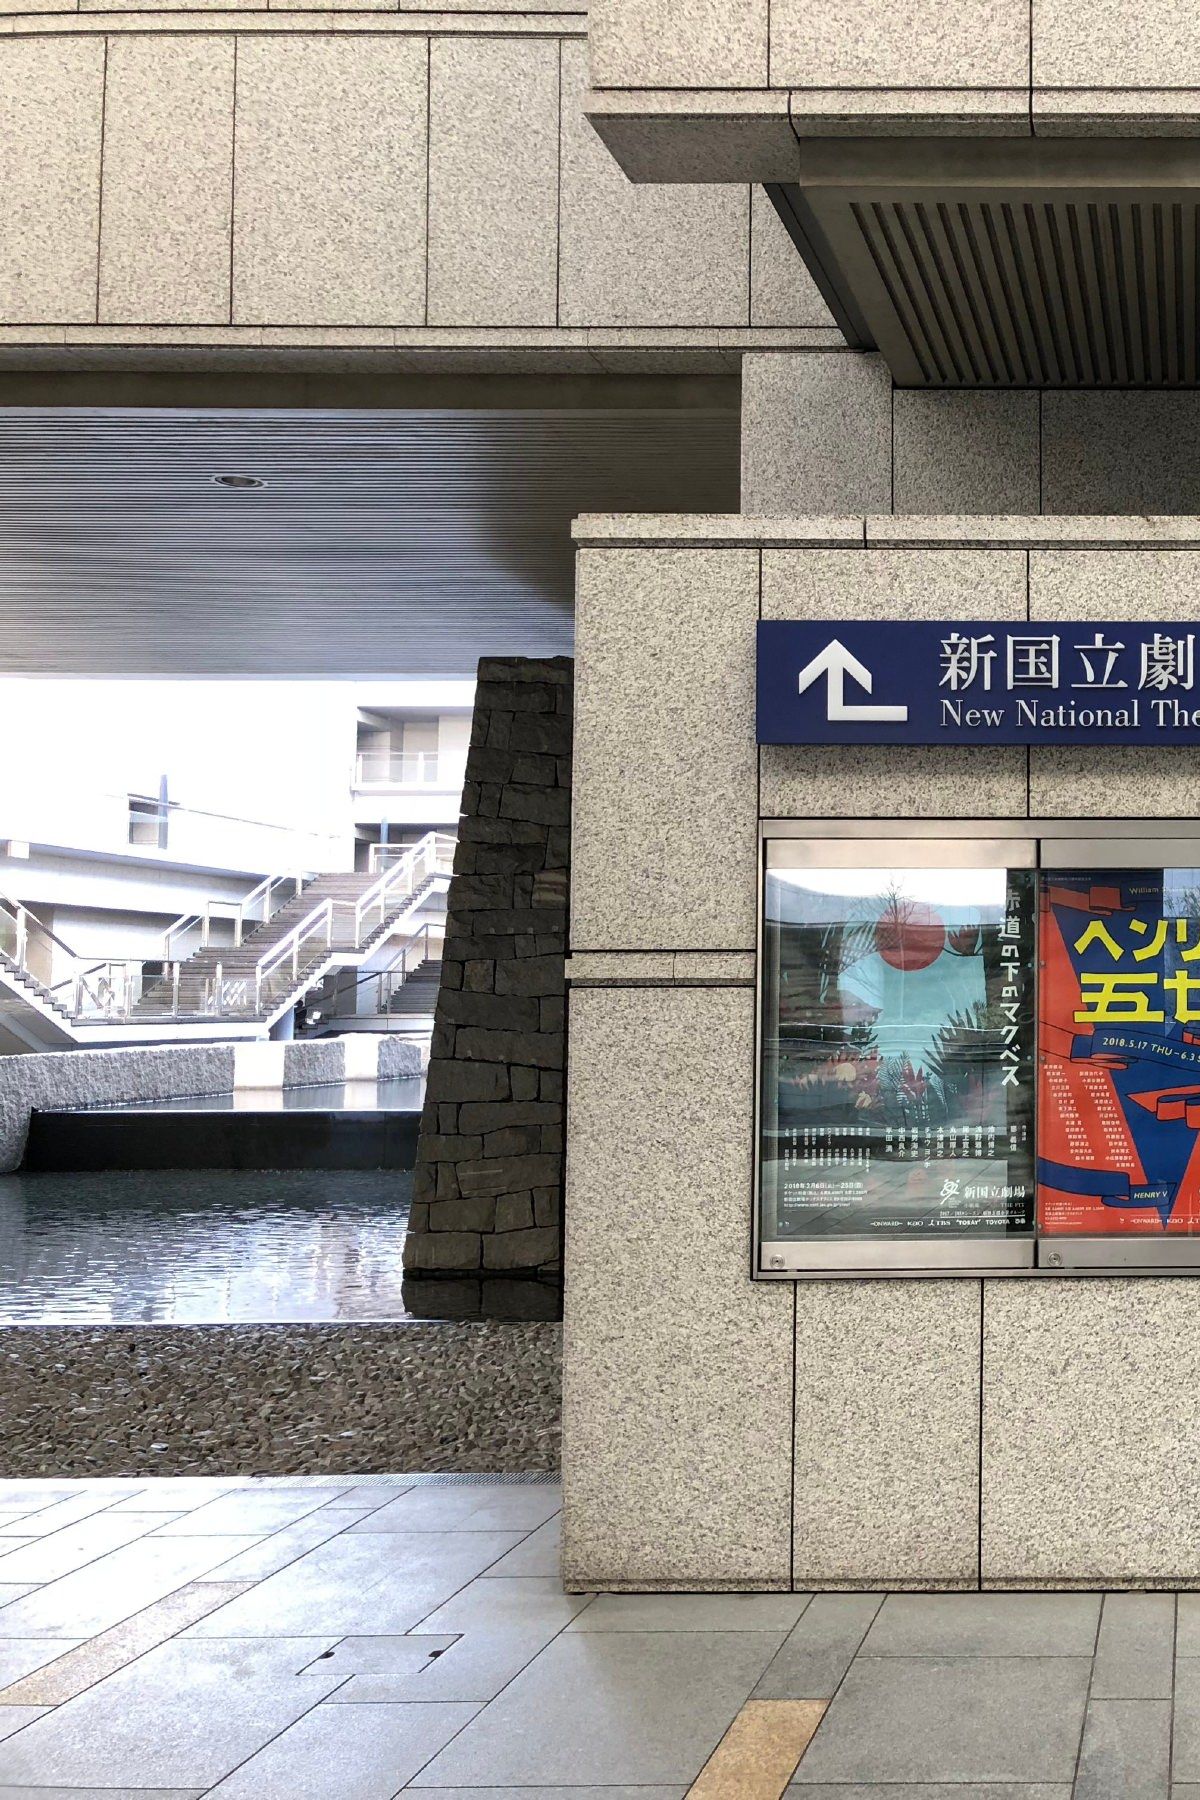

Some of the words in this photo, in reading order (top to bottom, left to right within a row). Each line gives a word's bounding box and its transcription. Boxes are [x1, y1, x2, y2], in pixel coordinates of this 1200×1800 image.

[939, 700, 1004, 728] New
[1016, 699, 1141, 728] National
[1128, 887, 1159, 895] William
[1103, 1037, 1148, 1050] 2018.5.17
[1151, 1043, 1173, 1056] THU
[964, 1185, 1026, 1199] 新国立劇場
